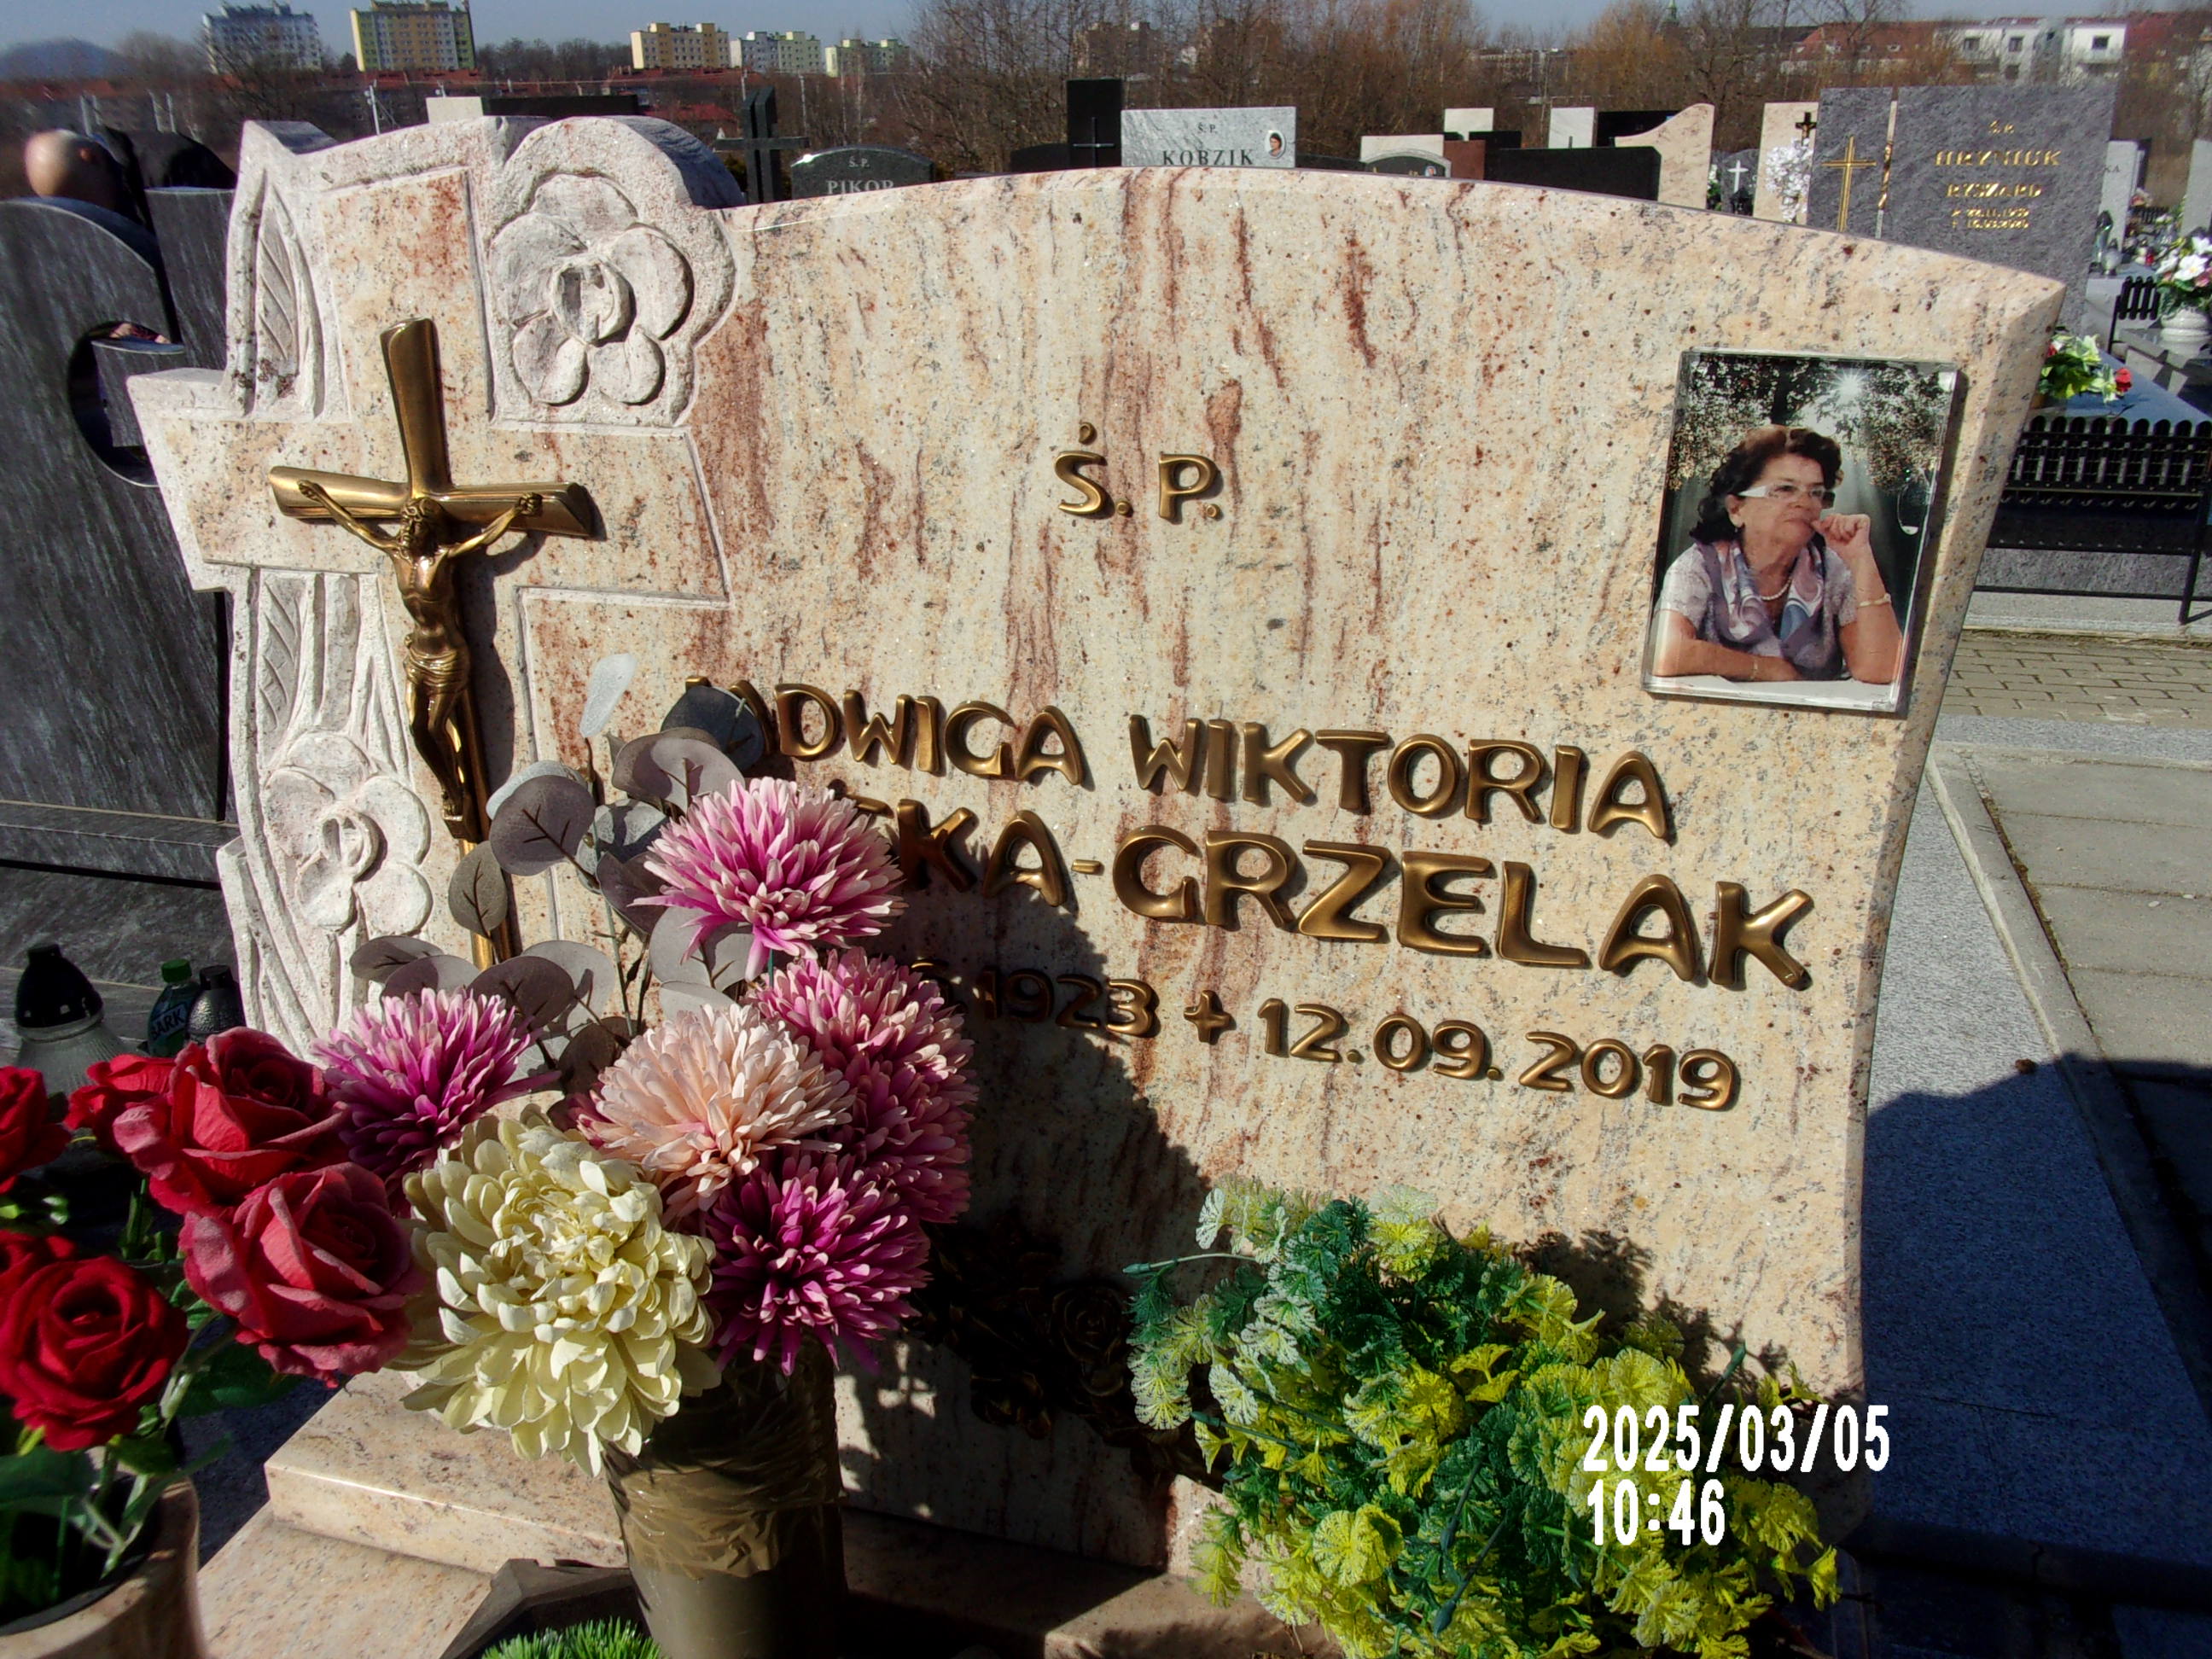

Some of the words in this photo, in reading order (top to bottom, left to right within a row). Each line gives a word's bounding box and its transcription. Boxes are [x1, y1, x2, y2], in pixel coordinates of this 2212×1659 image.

[1163, 148, 1254, 166] KOBZIK
[1129, 713, 1668, 840] WIKTORIA
[1258, 998, 1737, 1111] 12.09.2019
